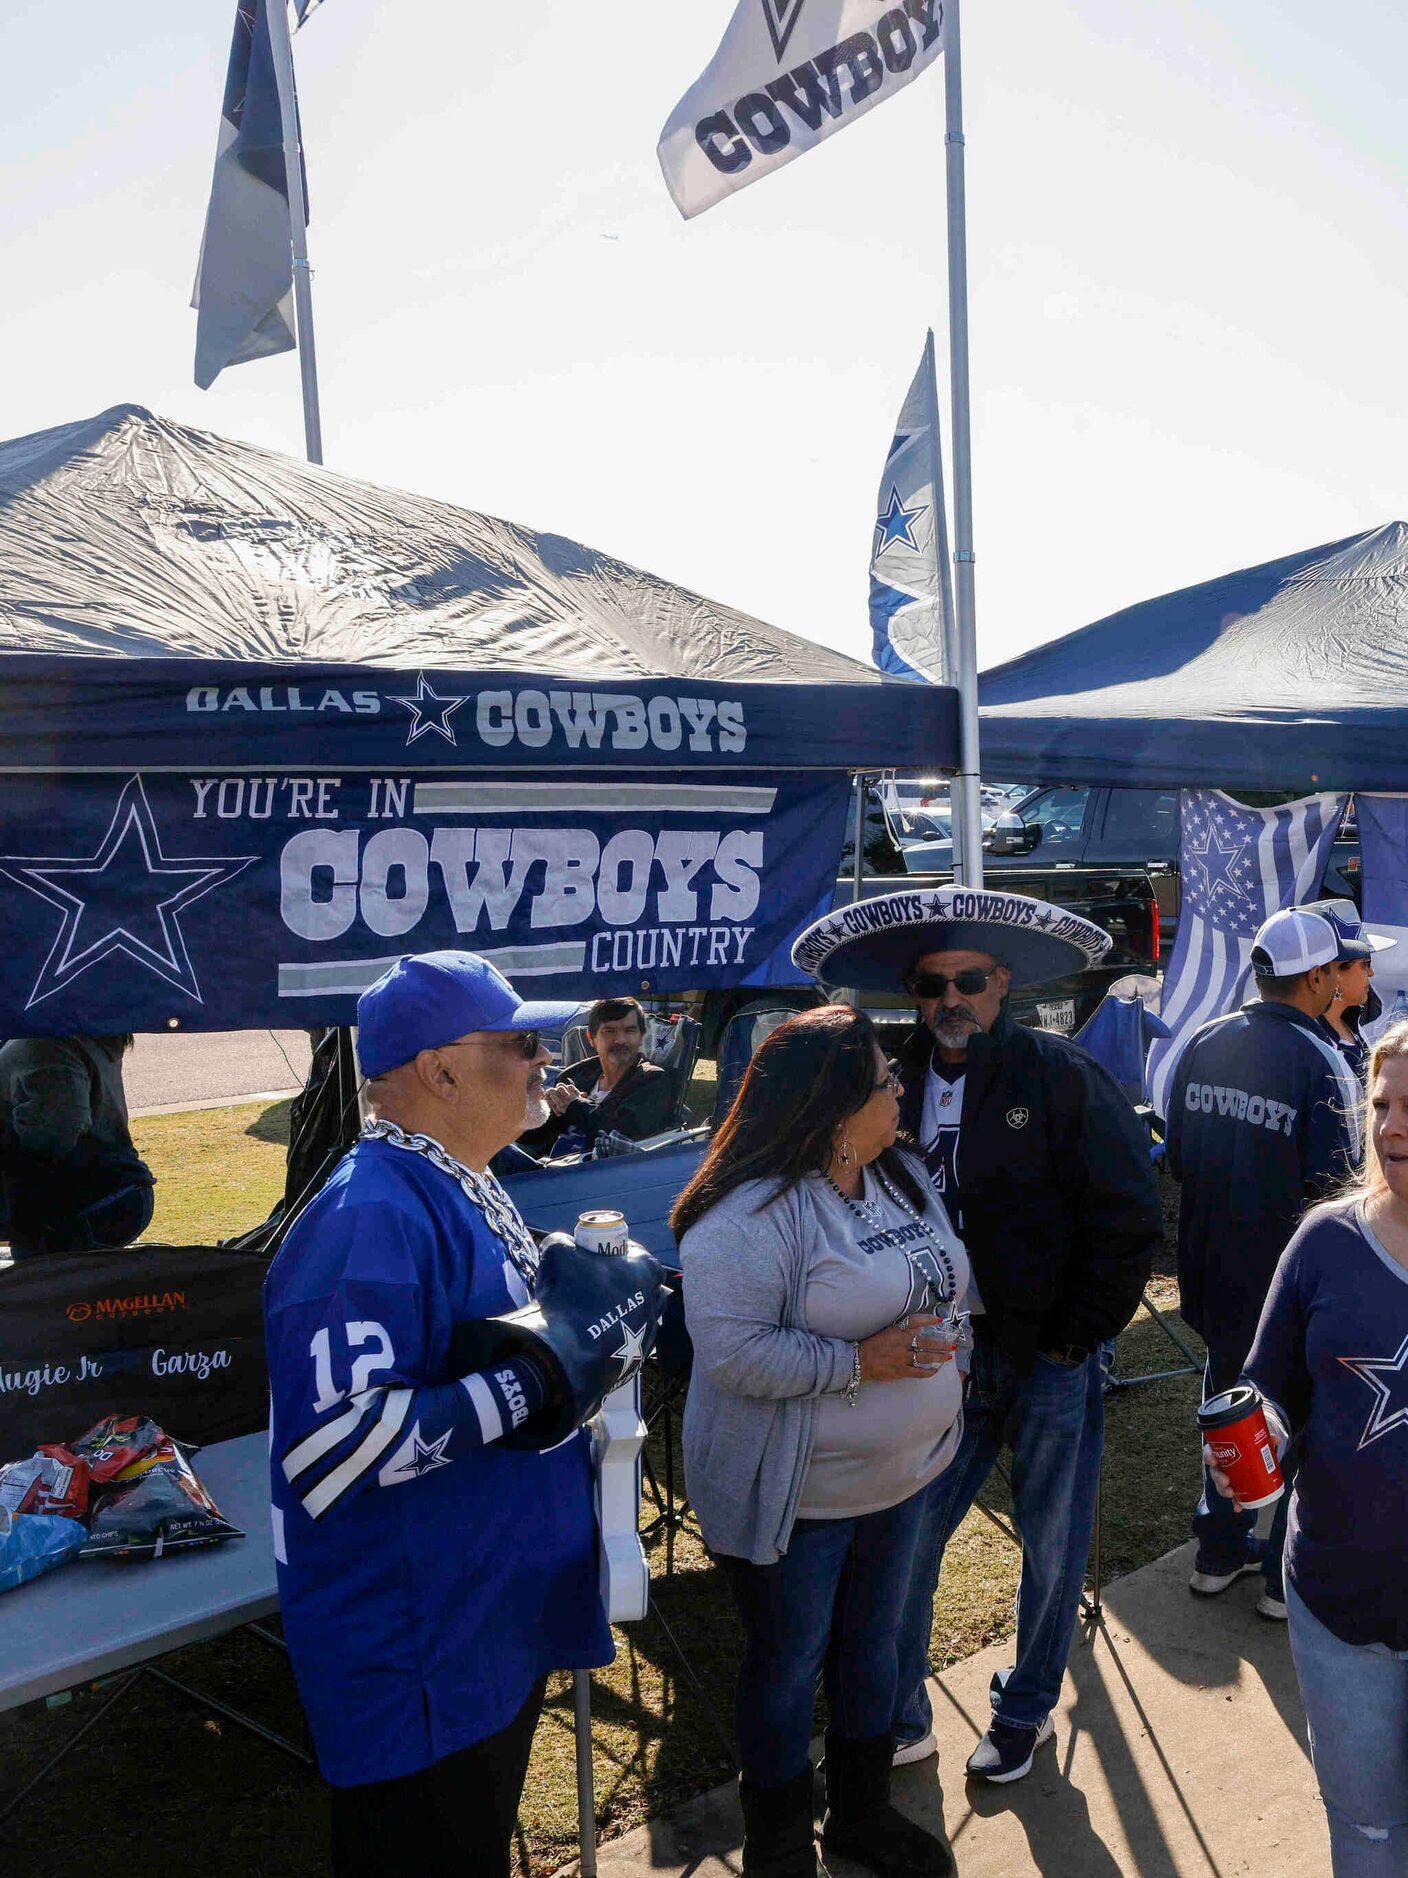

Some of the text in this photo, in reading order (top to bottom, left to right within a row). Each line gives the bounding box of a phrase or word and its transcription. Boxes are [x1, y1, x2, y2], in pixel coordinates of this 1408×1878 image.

[695, 0, 943, 174] COWBOY
[186, 686, 381, 714] DALLAS
[476, 689, 747, 753] COWBOYS
[189, 777, 411, 819] YOU'RE IN
[279, 828, 764, 942] COWBOYS
[842, 894, 924, 935] COWBOYS
[952, 893, 1038, 925] COWBOYS
[591, 926, 756, 973] COUNTRY
[1185, 1082, 1298, 1137] COWBOYS
[598, 1240, 628, 1256] Mod
[857, 1221, 934, 1255] COWBOYS
[96, 1291, 186, 1314] MAGELLAN
[587, 1290, 645, 1340] DALLAS
[76, 1355, 103, 1381] Jr
[152, 1348, 232, 1380] Garza
[310, 1321, 396, 1414] 12
[494, 1369, 530, 1429] BOYS
[1216, 1447, 1236, 1459] unity
[170, 1522, 181, 1530] NET
